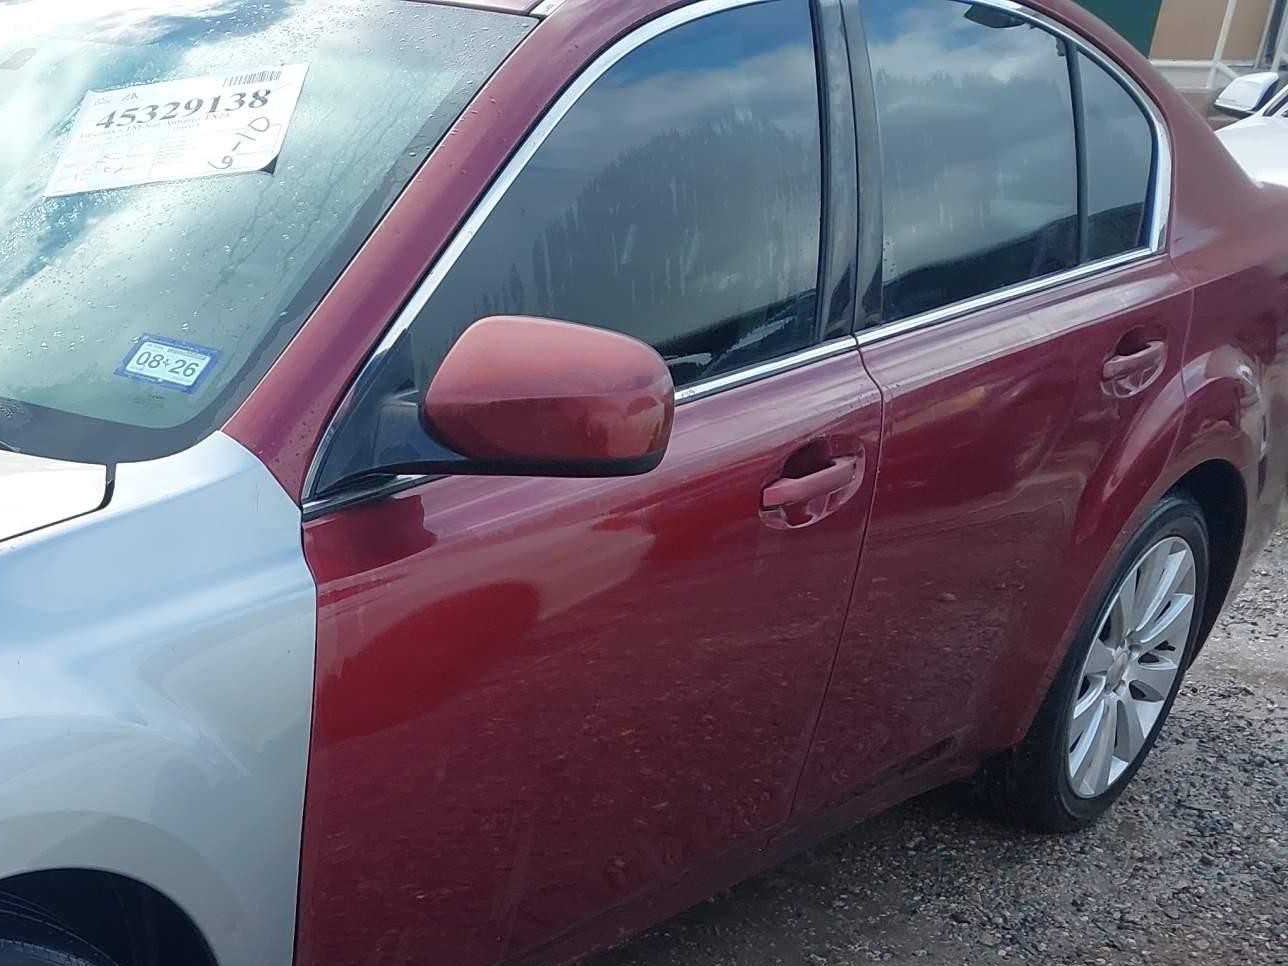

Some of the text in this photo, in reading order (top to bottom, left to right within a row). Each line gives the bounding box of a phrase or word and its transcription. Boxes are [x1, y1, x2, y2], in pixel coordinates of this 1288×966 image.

[95, 88, 272, 129] 45329138
[136, 352, 165, 369] 08
[168, 360, 199, 377] 26
